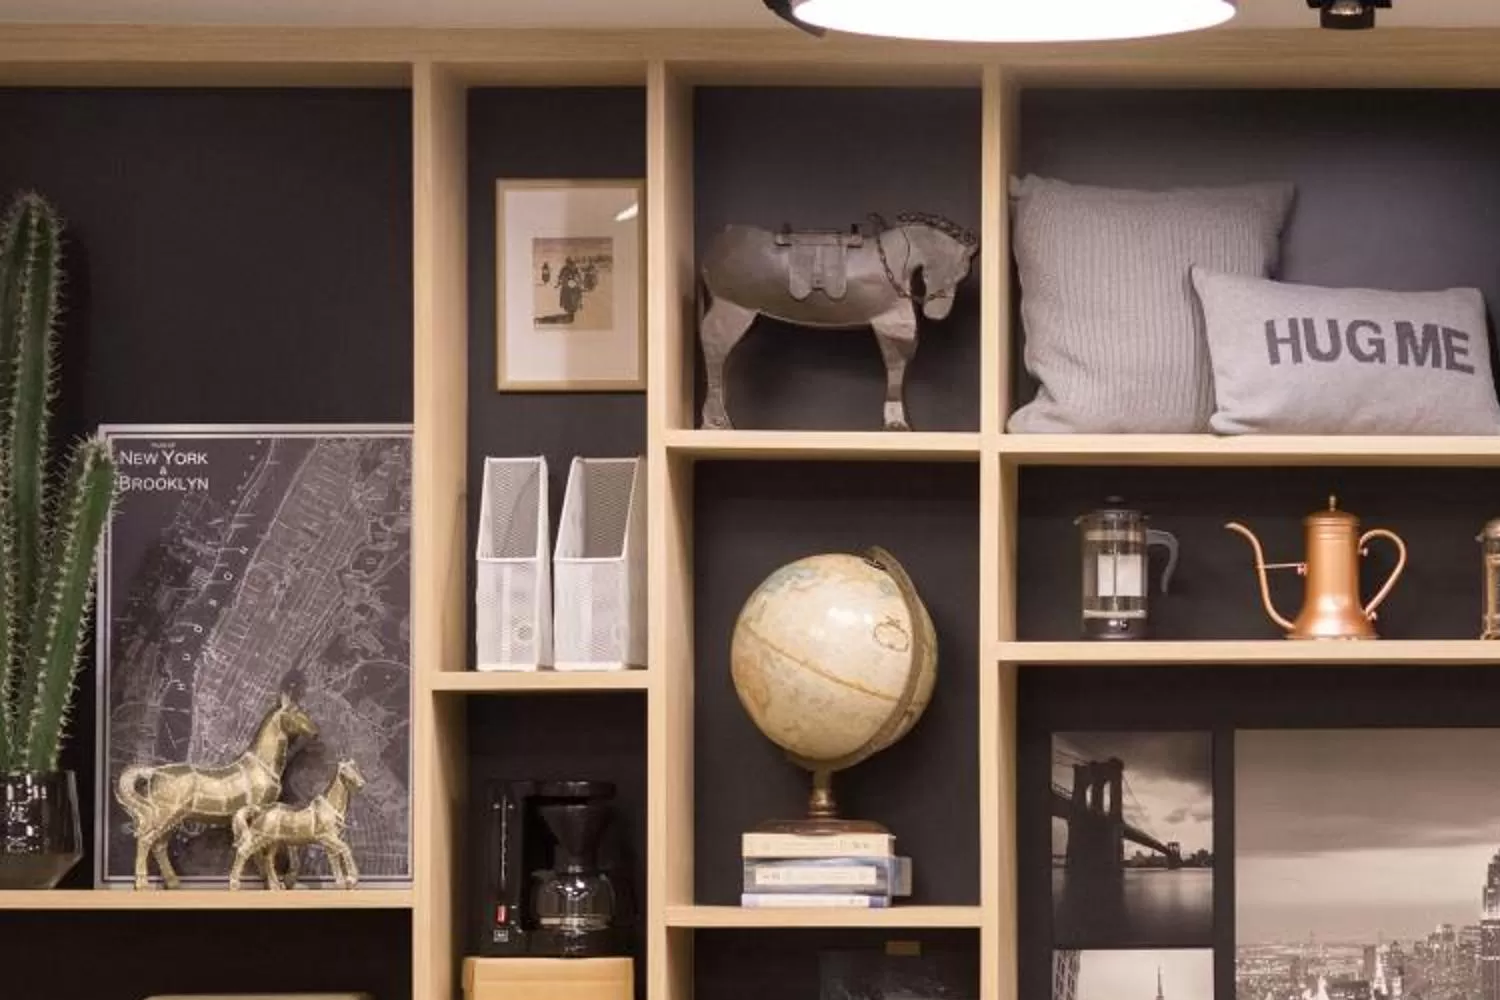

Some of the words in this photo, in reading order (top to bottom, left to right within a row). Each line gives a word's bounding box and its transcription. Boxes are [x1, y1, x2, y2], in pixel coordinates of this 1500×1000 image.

[1264, 317, 1386, 365] HUG
[1394, 320, 1475, 375] ME
[119, 450, 159, 465] NEW
[161, 449, 208, 465] YORK
[119, 475, 209, 491] BROOKLYN
